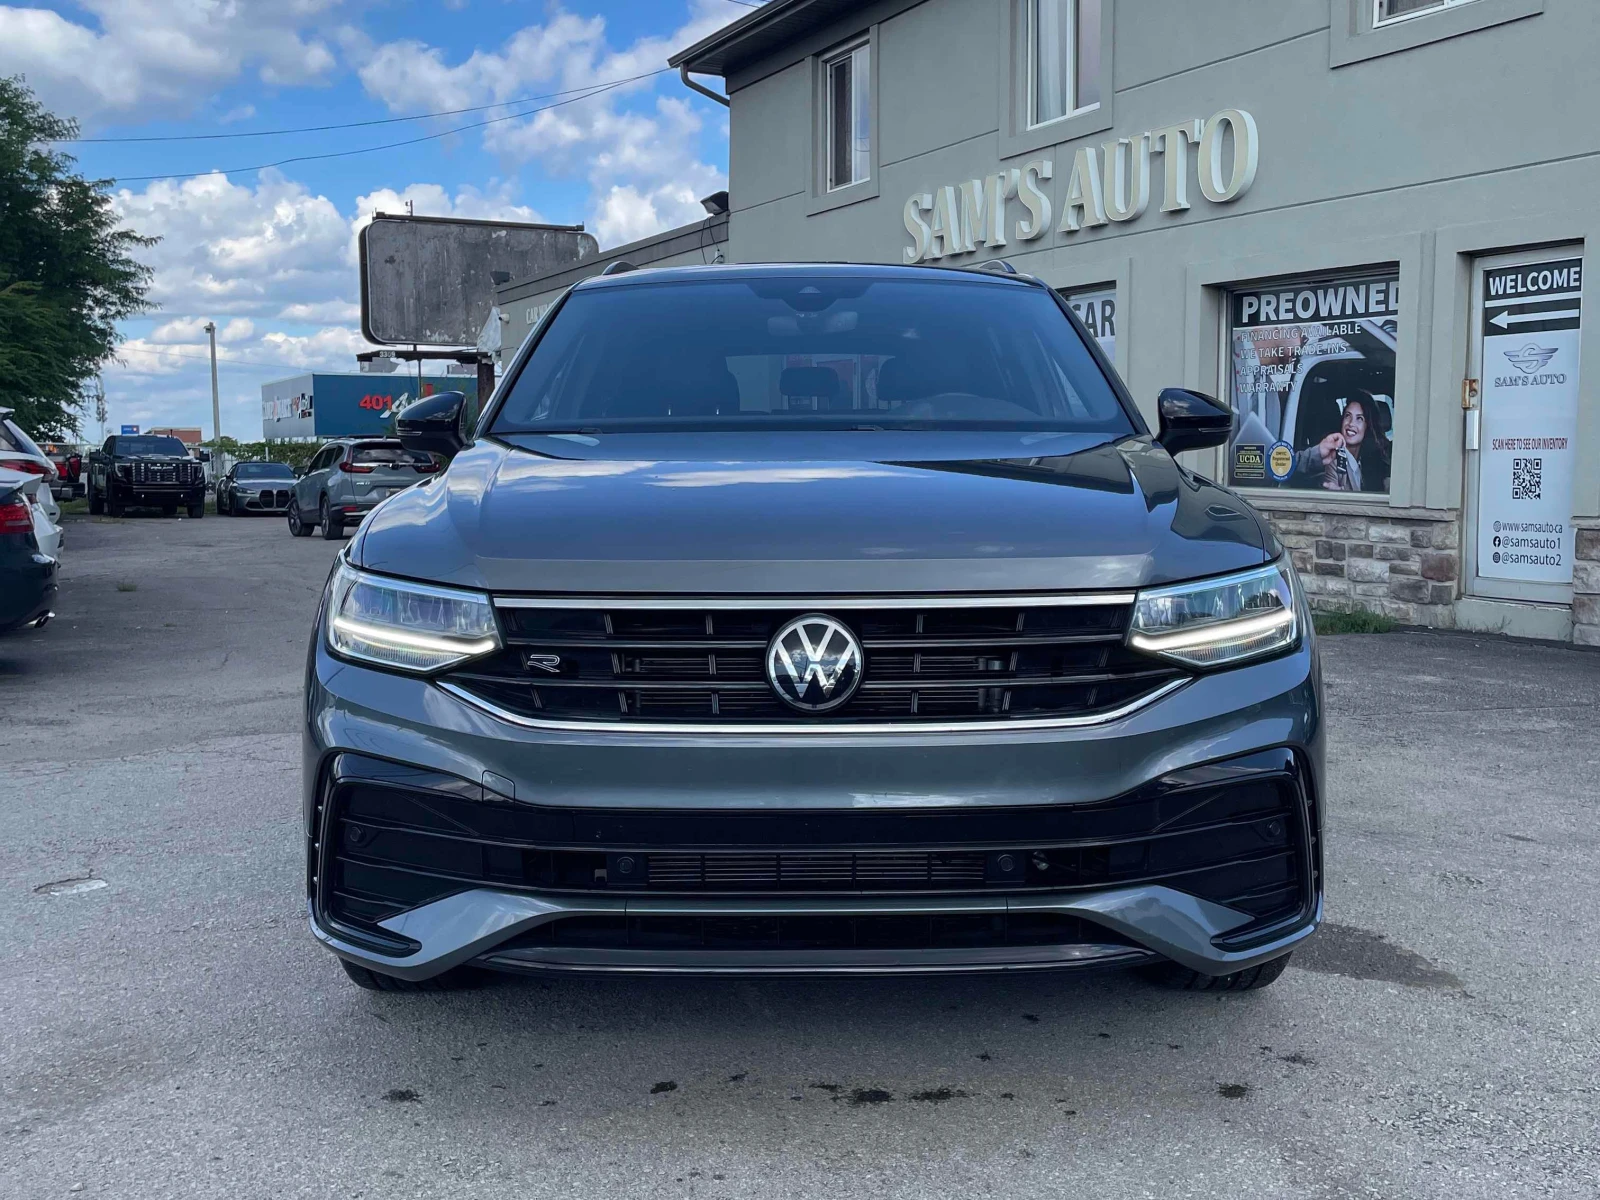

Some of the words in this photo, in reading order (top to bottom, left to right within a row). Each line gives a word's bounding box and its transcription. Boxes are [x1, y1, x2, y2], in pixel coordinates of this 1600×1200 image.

[902, 160, 1053, 264] SAM'S
[1058, 108, 1259, 233] AUTO
[1489, 267, 1580, 295] WELCOME
[1072, 300, 1116, 337] AR
[1241, 328, 1298, 341] FINANCING
[1301, 323, 1361, 338] AVAILABLE
[1241, 348, 1256, 359] WE
[1259, 346, 1284, 357] TAKE
[1287, 342, 1347, 356] TRADE-INS
[1240, 363, 1303, 376] APPRAISALS
[1240, 381, 1297, 393] WARRANTY
[1494, 375, 1529, 387] SAM'S
[1530, 373, 1567, 385] AUTO
[359, 394, 392, 411] 401
[1492, 438, 1504, 450] SCAN
[1505, 438, 1516, 450] HERE
[1516, 438, 1522, 450] TO
[1523, 438, 1531, 450] SEE
[1531, 438, 1541, 450] OUR
[1542, 437, 1568, 450] INVENTORY
[1239, 454, 1260, 463] UCDA
[1502, 535, 1561, 550] @samsauto1
[1501, 551, 1562, 566] @samsauto2
